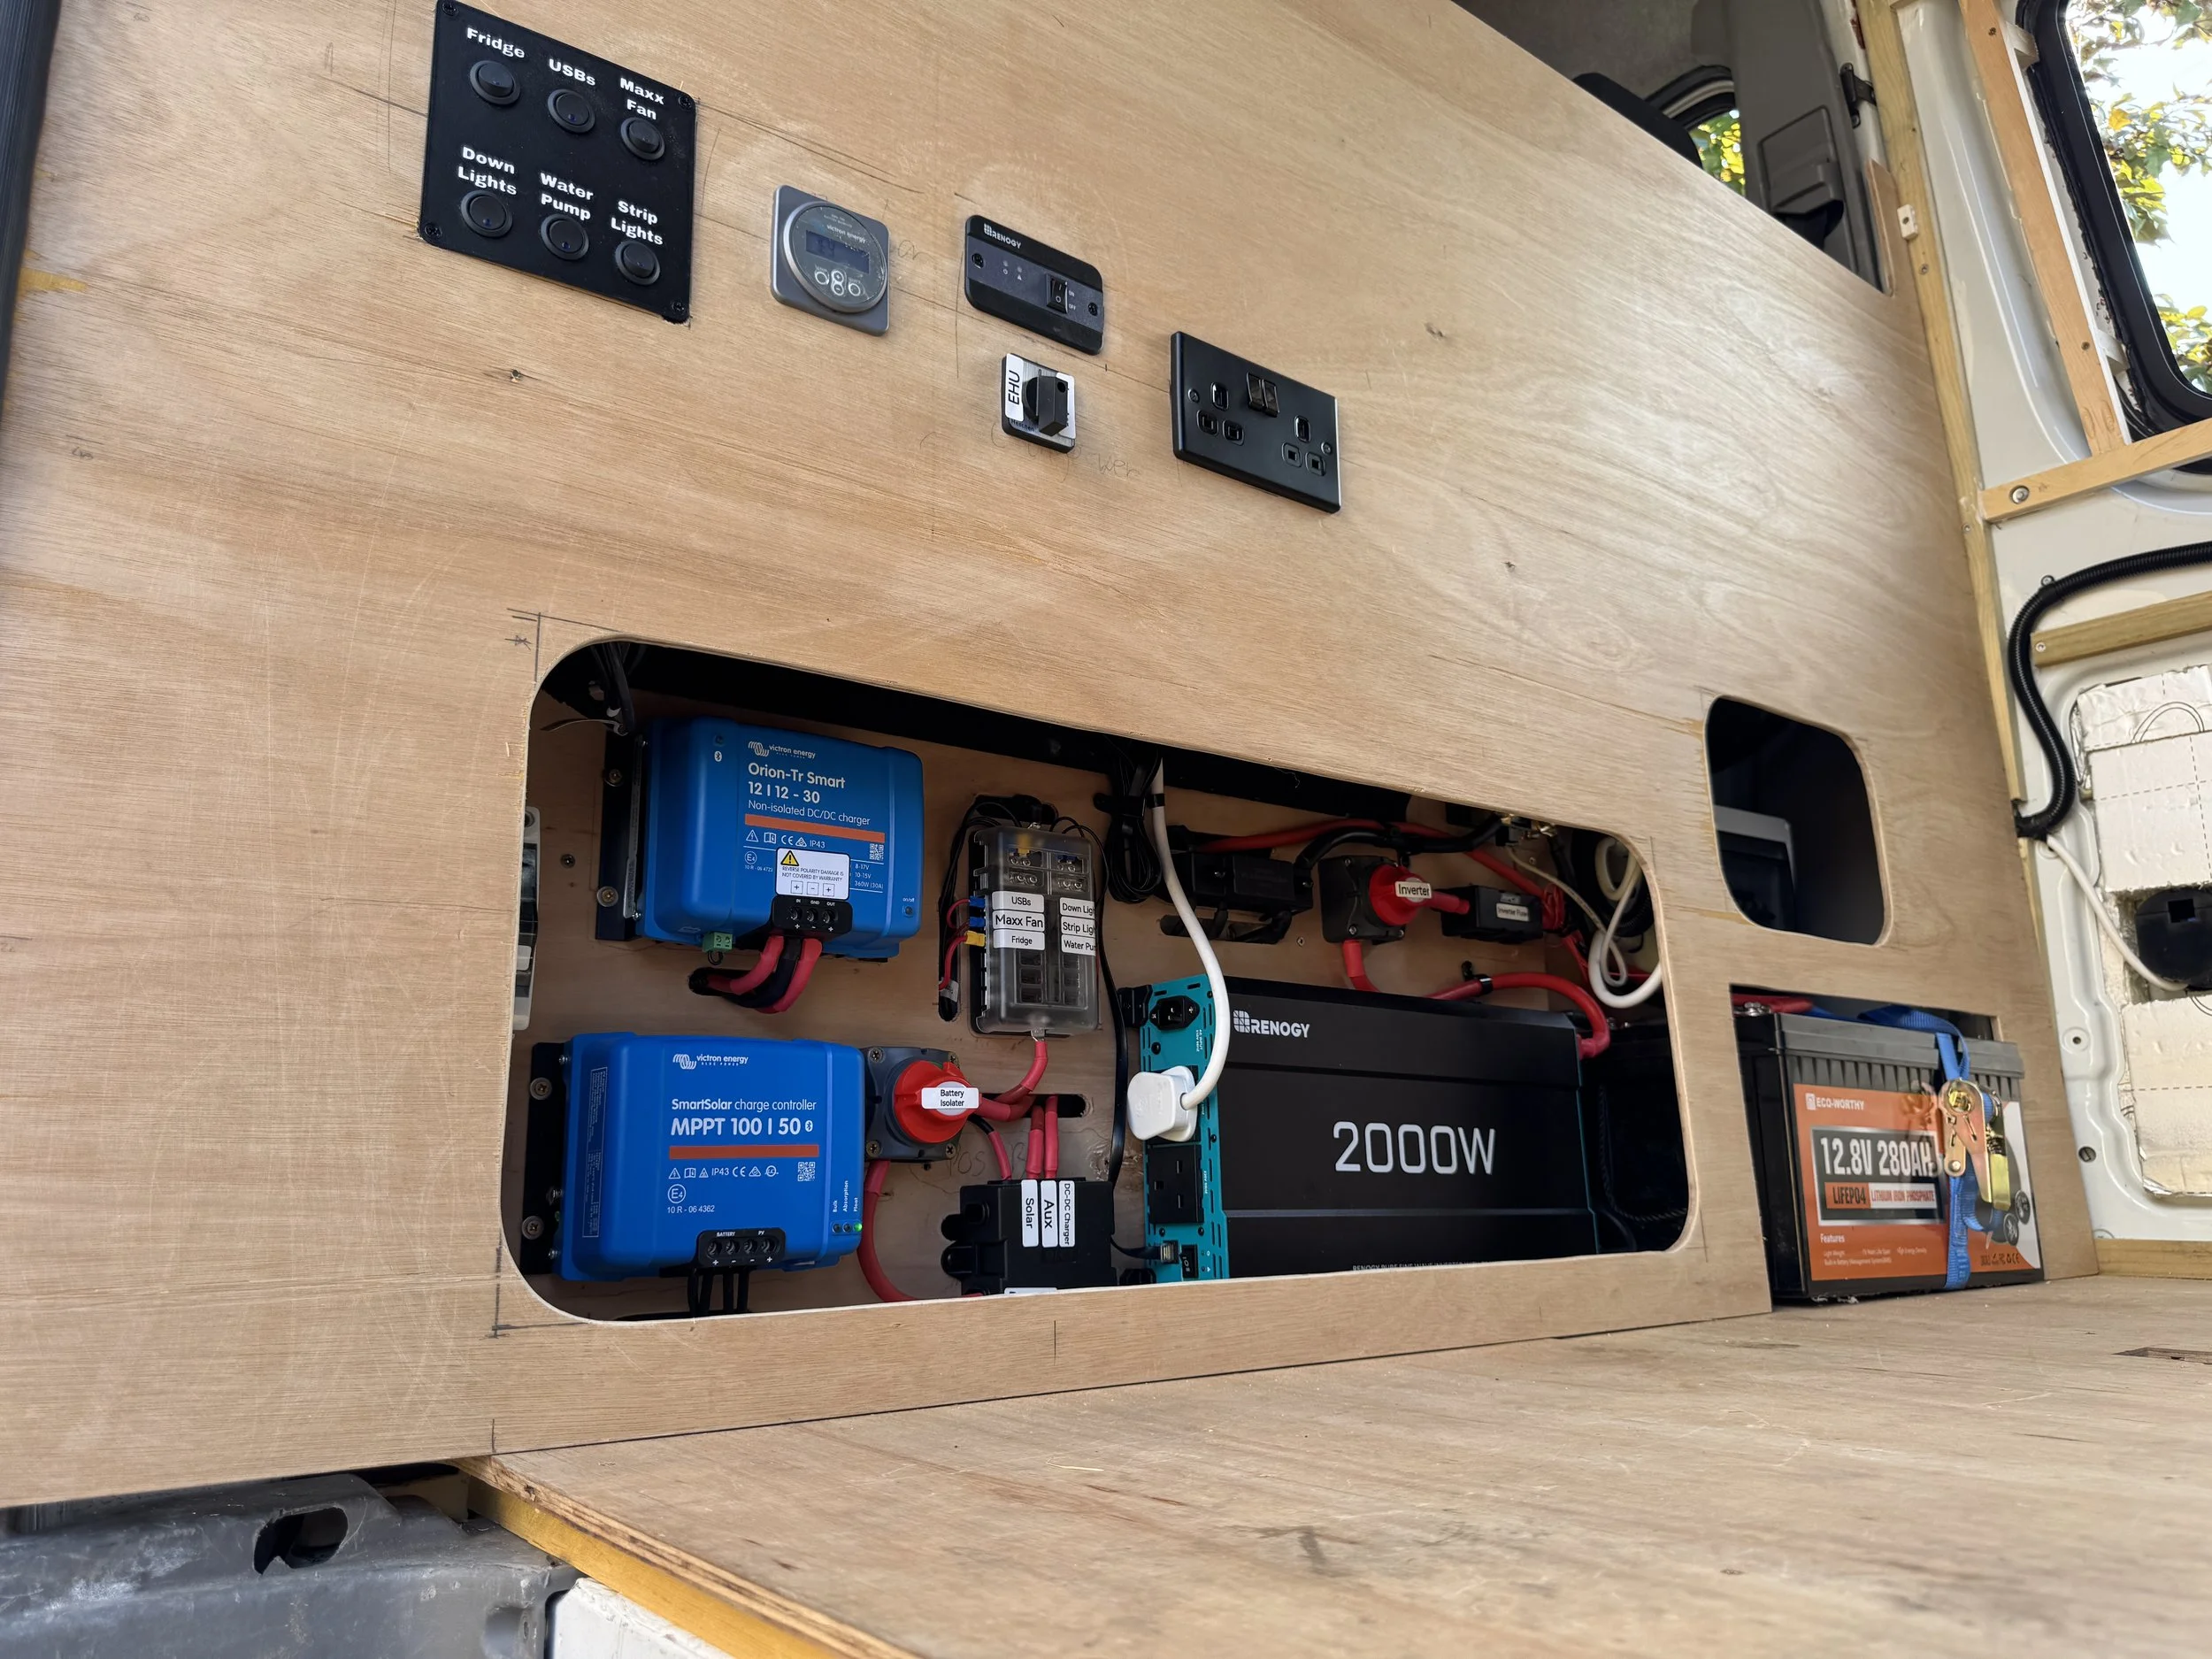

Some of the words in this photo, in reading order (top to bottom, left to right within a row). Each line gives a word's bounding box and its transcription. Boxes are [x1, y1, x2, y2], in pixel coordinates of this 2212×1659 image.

[466, 27, 526, 59] Fridge
[548, 58, 596, 87] USBs
[619, 77, 664, 106] Maxx
[626, 99, 657, 120] Fan
[462, 147, 516, 174] Down
[457, 166, 518, 196] Lights
[540, 173, 595, 201] Water
[541, 194, 591, 221] Pump
[618, 200, 659, 225] Strip
[611, 218, 664, 246] Lights
[992, 230, 1022, 250] RENOGY
[1009, 370, 1020, 405] EHU
[769, 744, 792, 754] victron
[793, 749, 816, 759] energy
[749, 763, 804, 782] Orion-Tr
[807, 772, 846, 789] Smart
[749, 780, 763, 795] 12
[775, 785, 789, 800] 12
[803, 789, 820, 804] 30
[748, 800, 805, 816] Non-isolated
[807, 809, 836, 821] DC/DC
[838, 813, 871, 826] charger
[810, 840, 826, 849] IP43
[1398, 884, 1431, 896] Inverter
[1011, 896, 1032, 906] USBs
[1062, 902, 1082, 913] Down
[995, 914, 1024, 926] Maxx
[1025, 917, 1044, 928] Fan
[1497, 907, 1516, 916] Inverter
[1063, 922, 1081, 934] Strip
[1011, 935, 1033, 945] Fridge
[1064, 939, 1085, 950] Water
[1250, 1018, 1310, 1038] RENOGY
[723, 1056, 749, 1064] energy
[940, 1089, 964, 1099] Battery
[1816, 1096, 1865, 1110] ECO-WORTHY
[672, 1098, 733, 1110] SmartSolar
[734, 1098, 770, 1113] charge
[772, 1098, 817, 1110] controller
[671, 1118, 726, 1135] MPPT
[730, 1118, 762, 1135] 100
[778, 1117, 801, 1135] 50
[1333, 1120, 1496, 1175] 2000W
[1820, 1137, 1872, 1176] 12.8V
[1877, 1139, 1934, 1177] 280AH
[711, 1167, 729, 1176] IP43
[1832, 1187, 1866, 1204] LIFEPO4
[698, 1204, 716, 1213] 4362
[1025, 1197, 1034, 1229] Solar
[1044, 1199, 1055, 1229] Aux
[1820, 1233, 1845, 1243] Features
